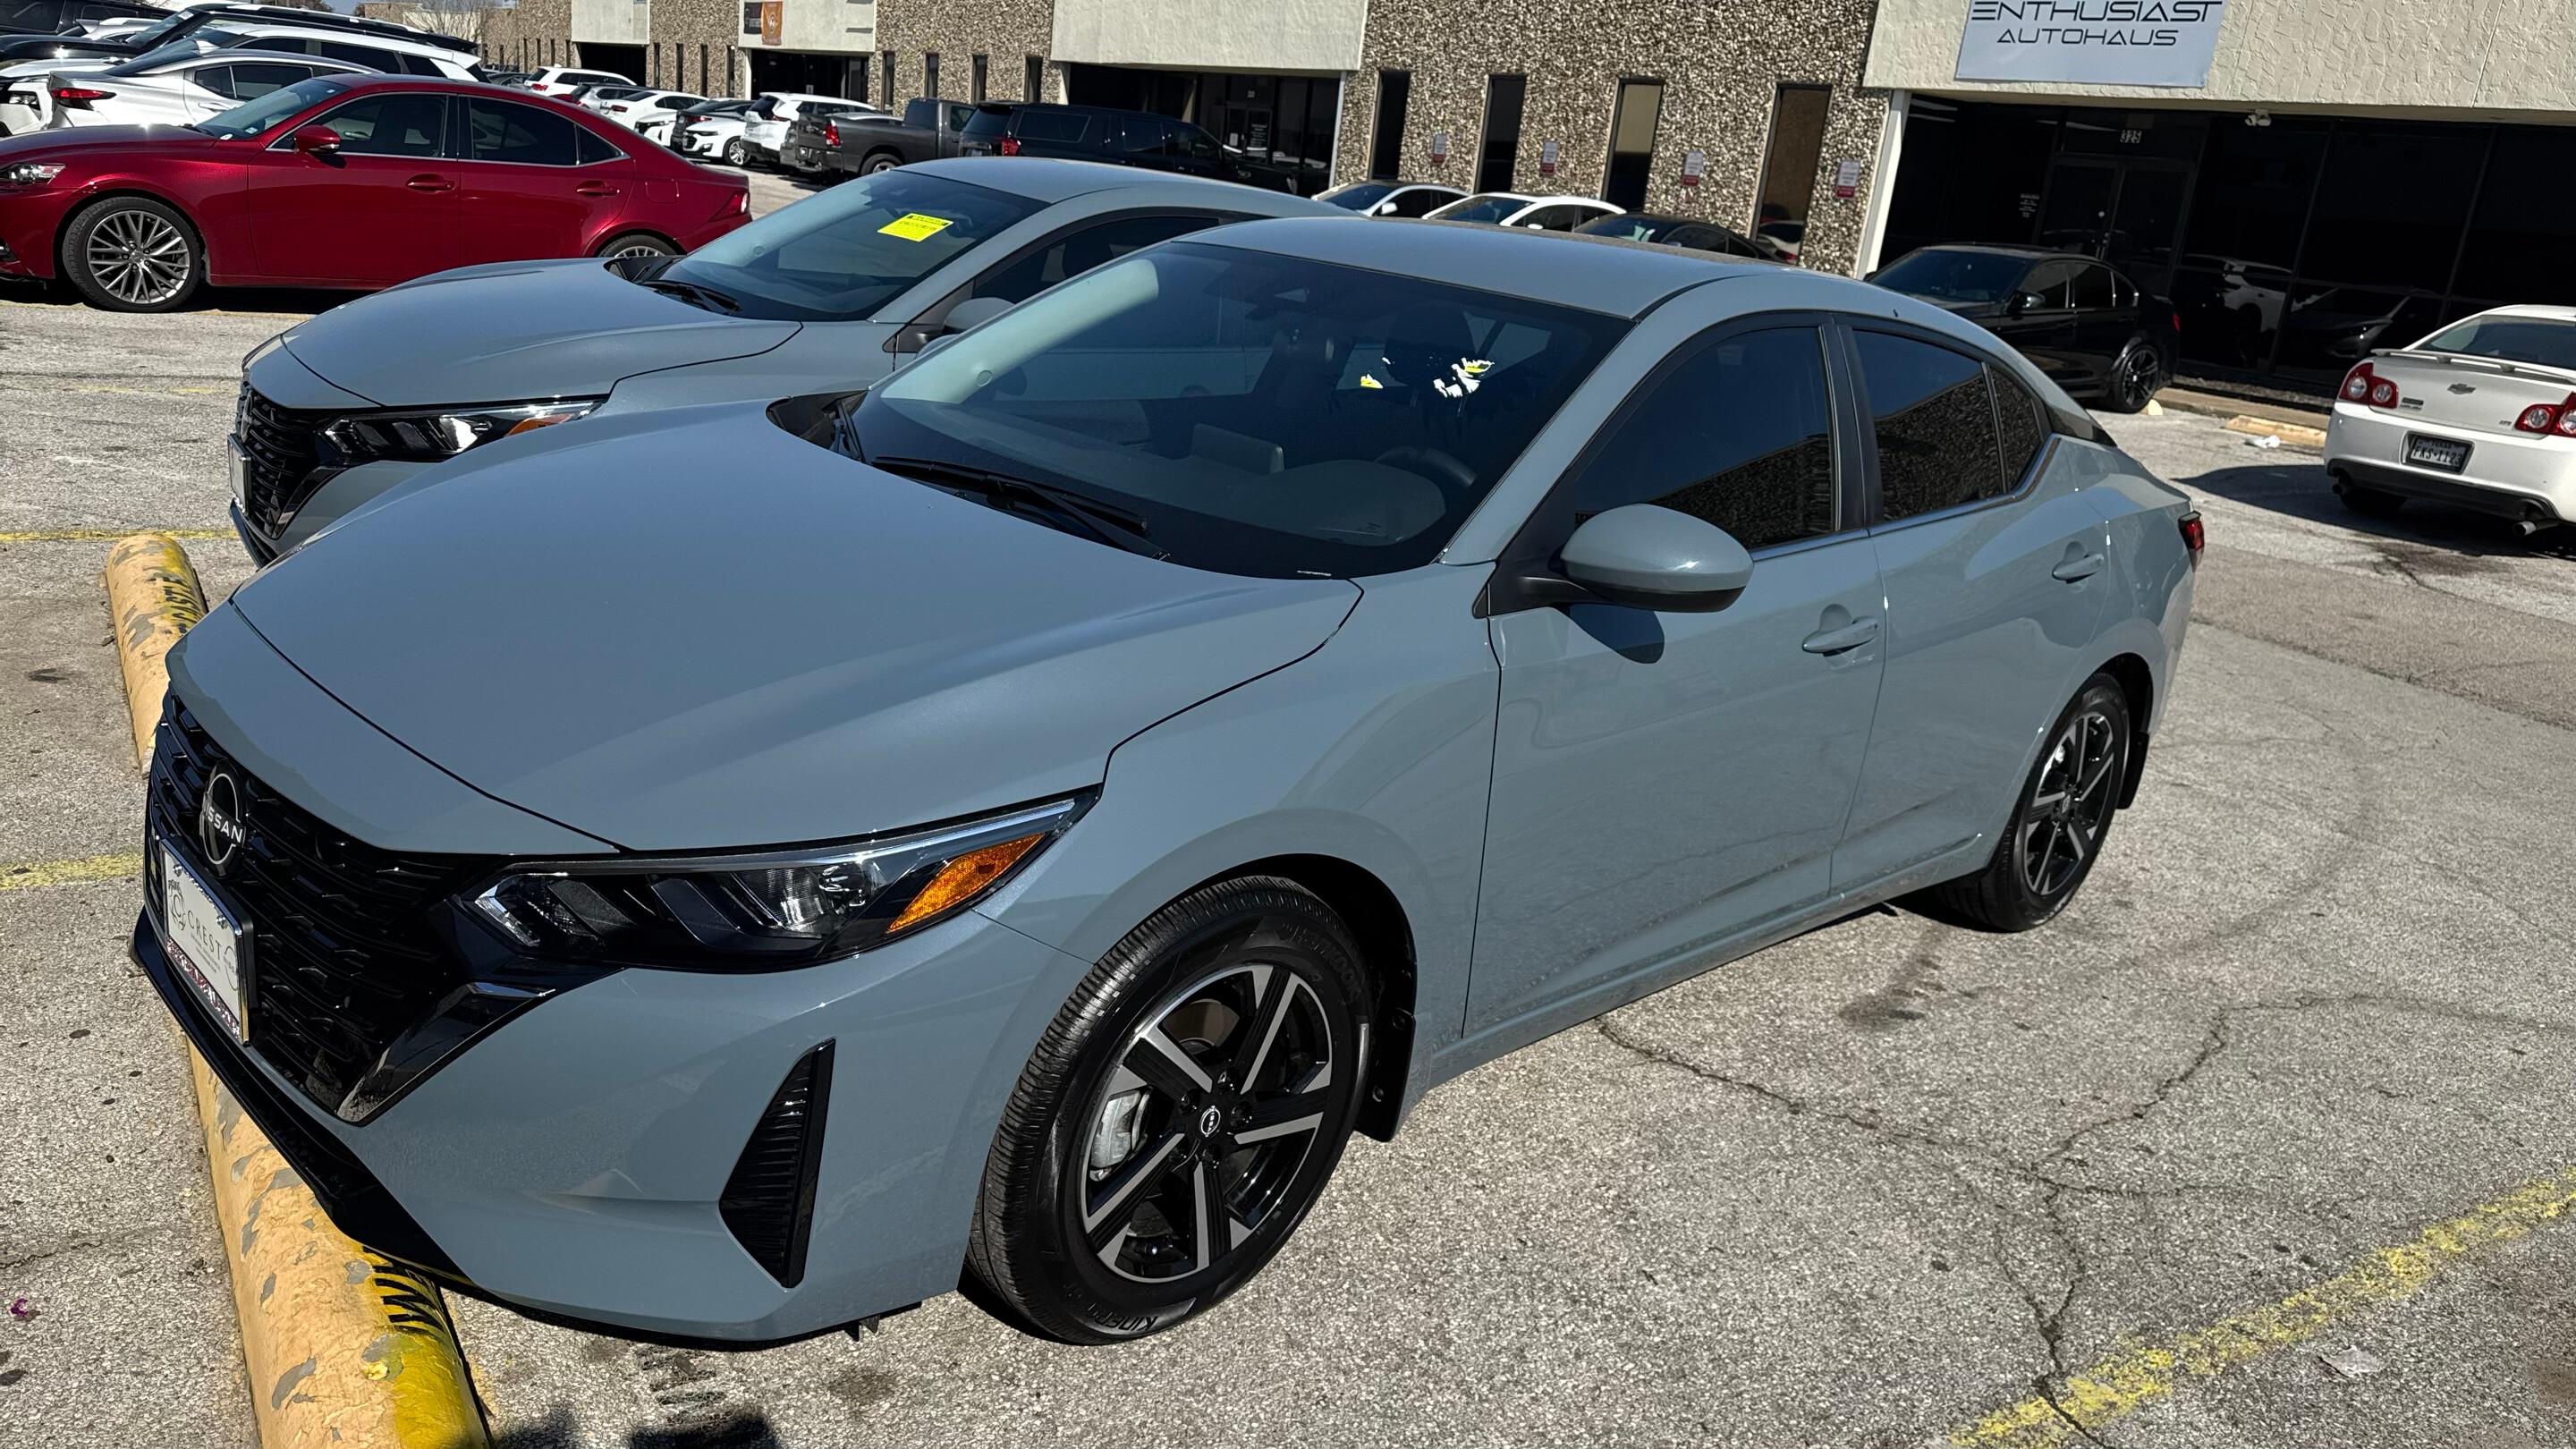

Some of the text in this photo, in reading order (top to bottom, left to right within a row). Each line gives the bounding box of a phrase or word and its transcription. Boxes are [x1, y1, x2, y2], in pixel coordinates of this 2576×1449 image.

[1971, 1, 2223, 22] ENTHUSIAST
[1997, 28, 2179, 46] AUTOHAUS
[188, 910, 221, 960] CREST
